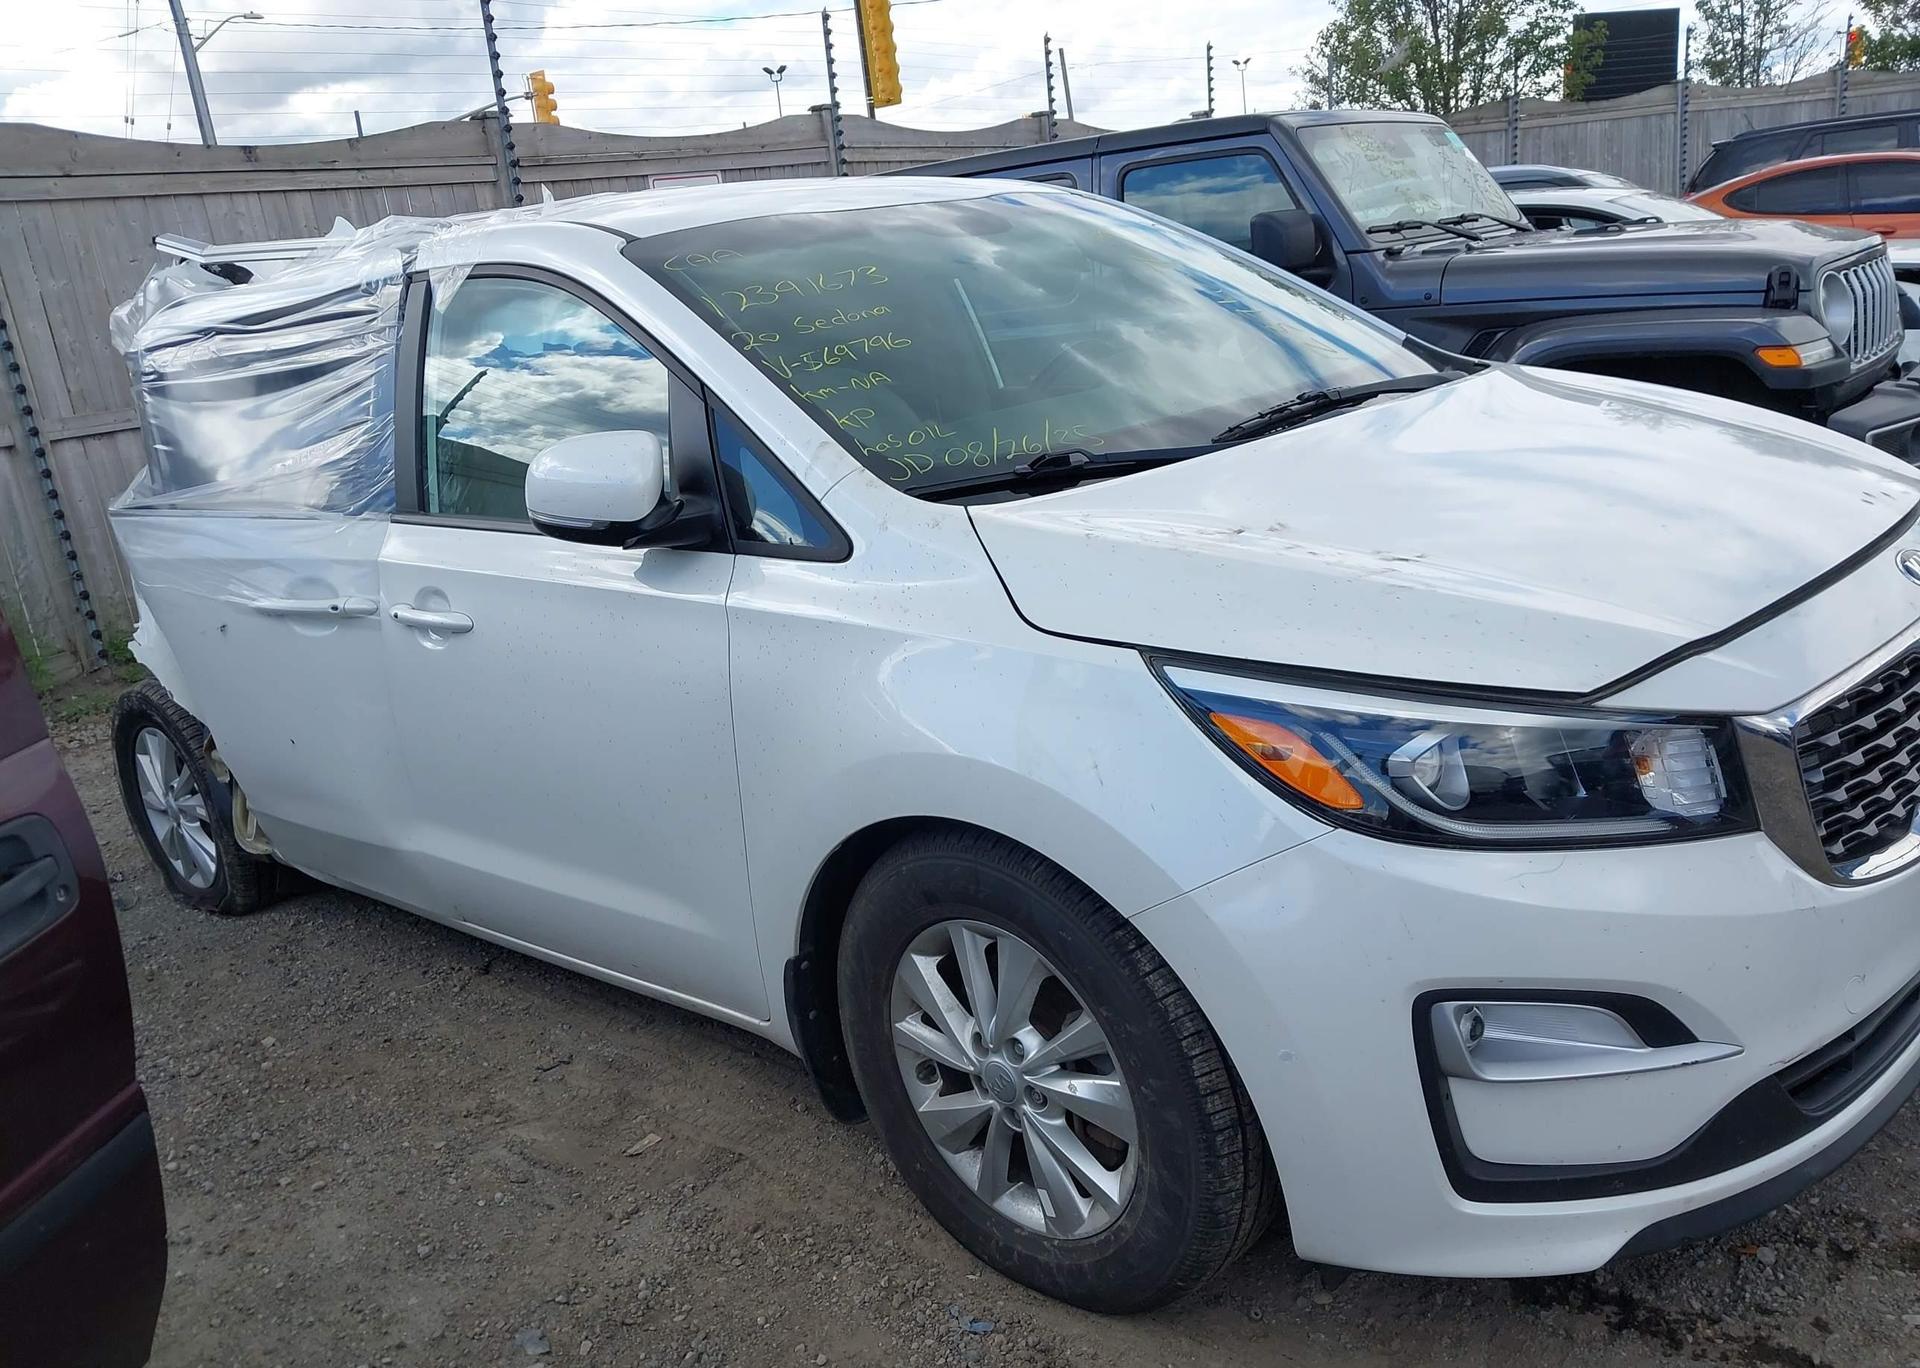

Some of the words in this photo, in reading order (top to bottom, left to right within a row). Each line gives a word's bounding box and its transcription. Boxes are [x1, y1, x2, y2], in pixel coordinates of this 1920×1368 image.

[663, 249, 744, 271] CAA
[700, 265, 889, 319] 12391673
[731, 331, 780, 351] 20
[793, 303, 893, 335] Sedona
[889, 452, 935, 481] JD
